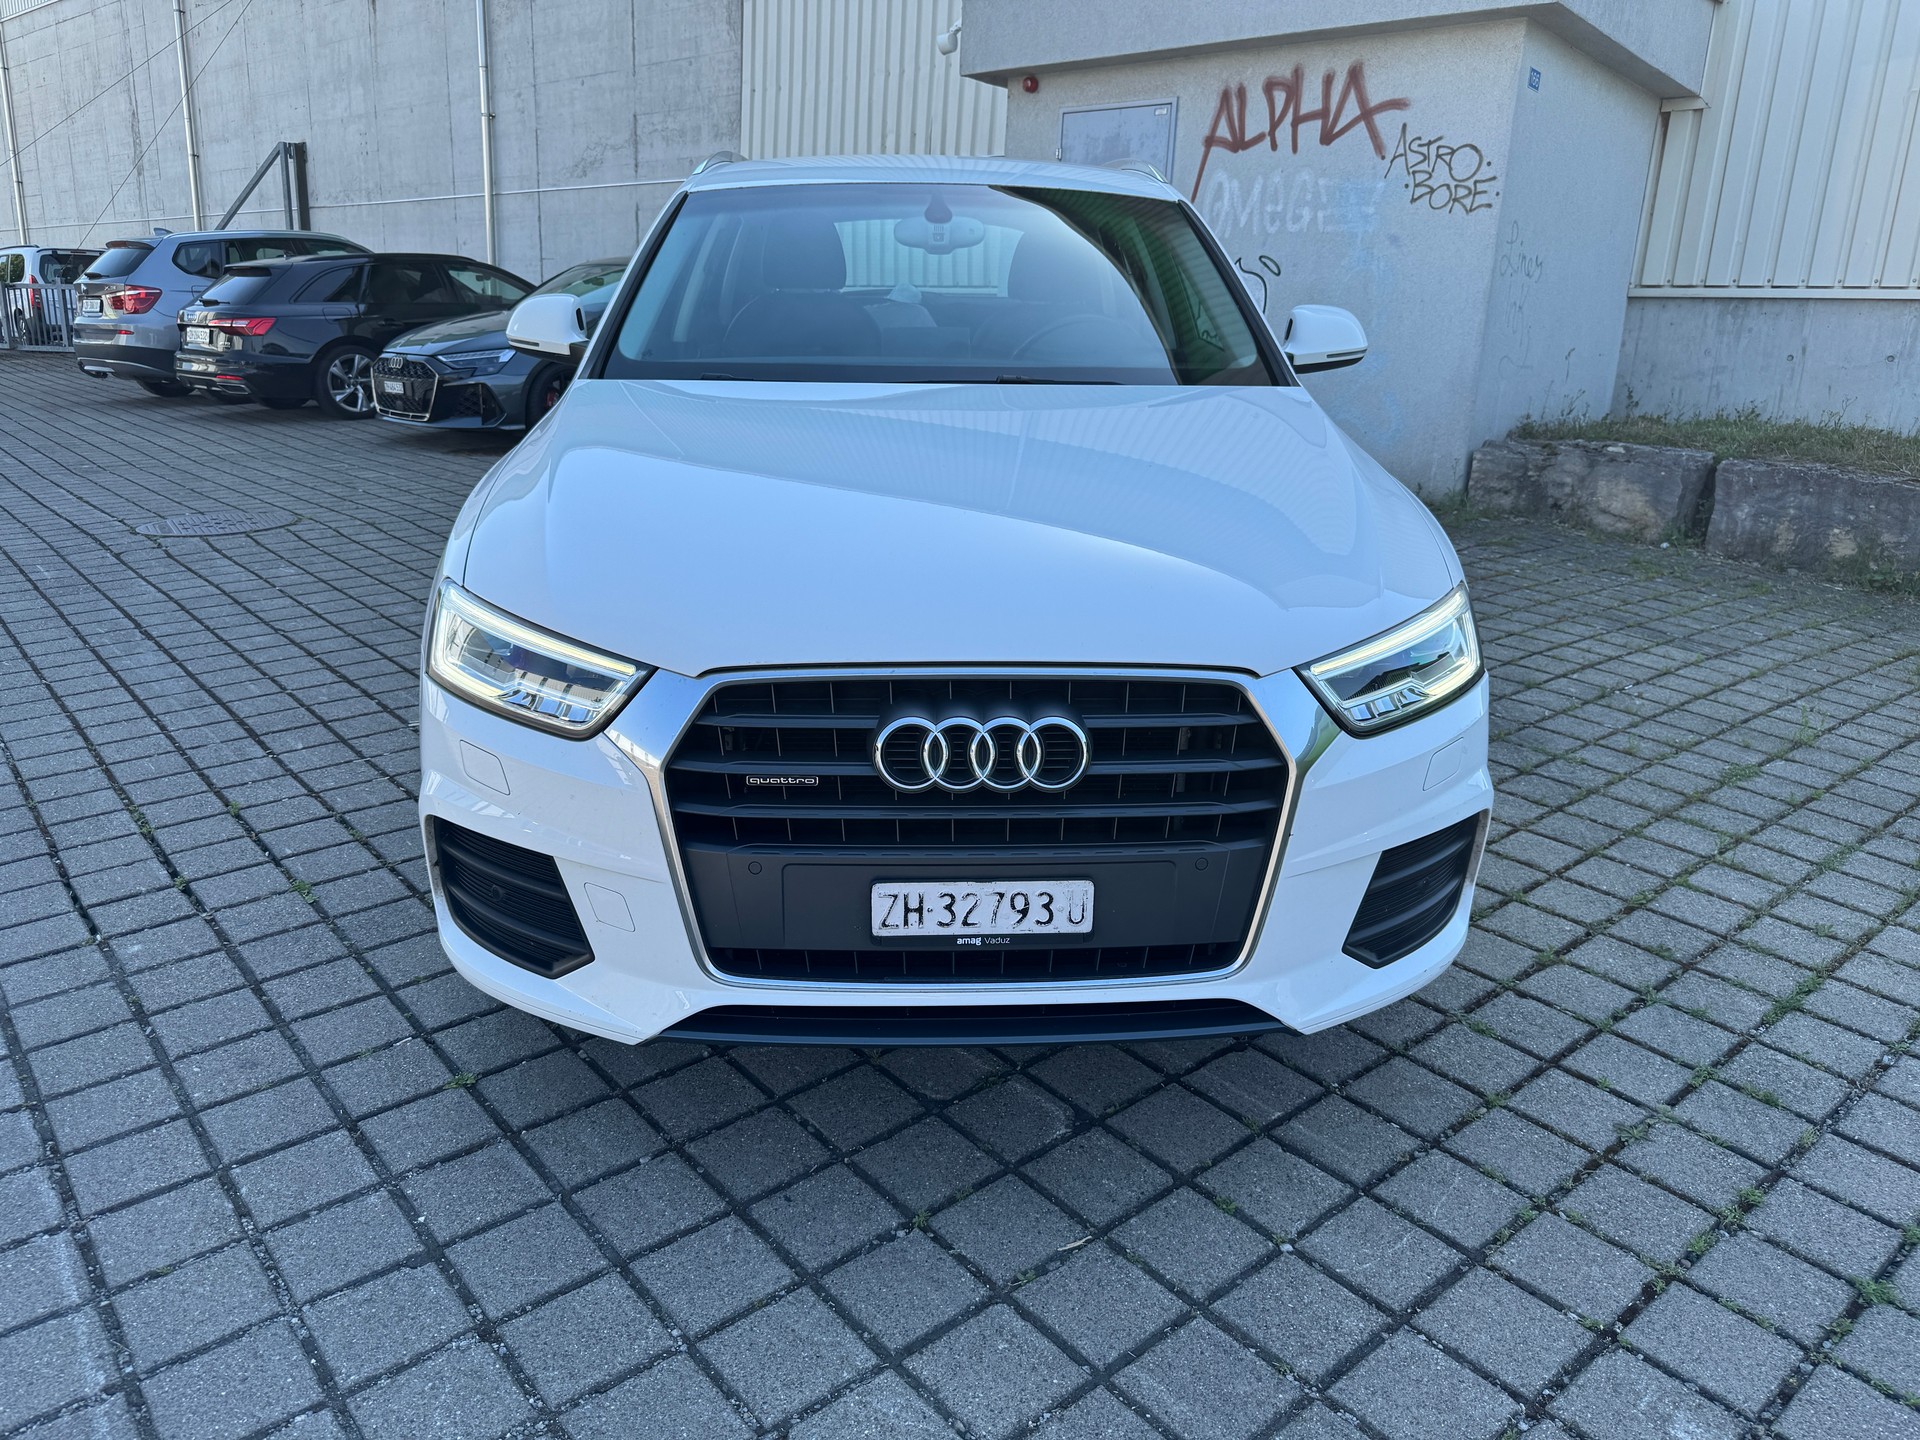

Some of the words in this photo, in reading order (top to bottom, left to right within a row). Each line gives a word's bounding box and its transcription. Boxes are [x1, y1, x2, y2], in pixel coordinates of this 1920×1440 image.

[1191, 61, 1411, 203] ALPHA
[749, 777, 815, 785] quattro
[956, 937, 982, 946] amag
[984, 936, 1011, 945] Vaduz
